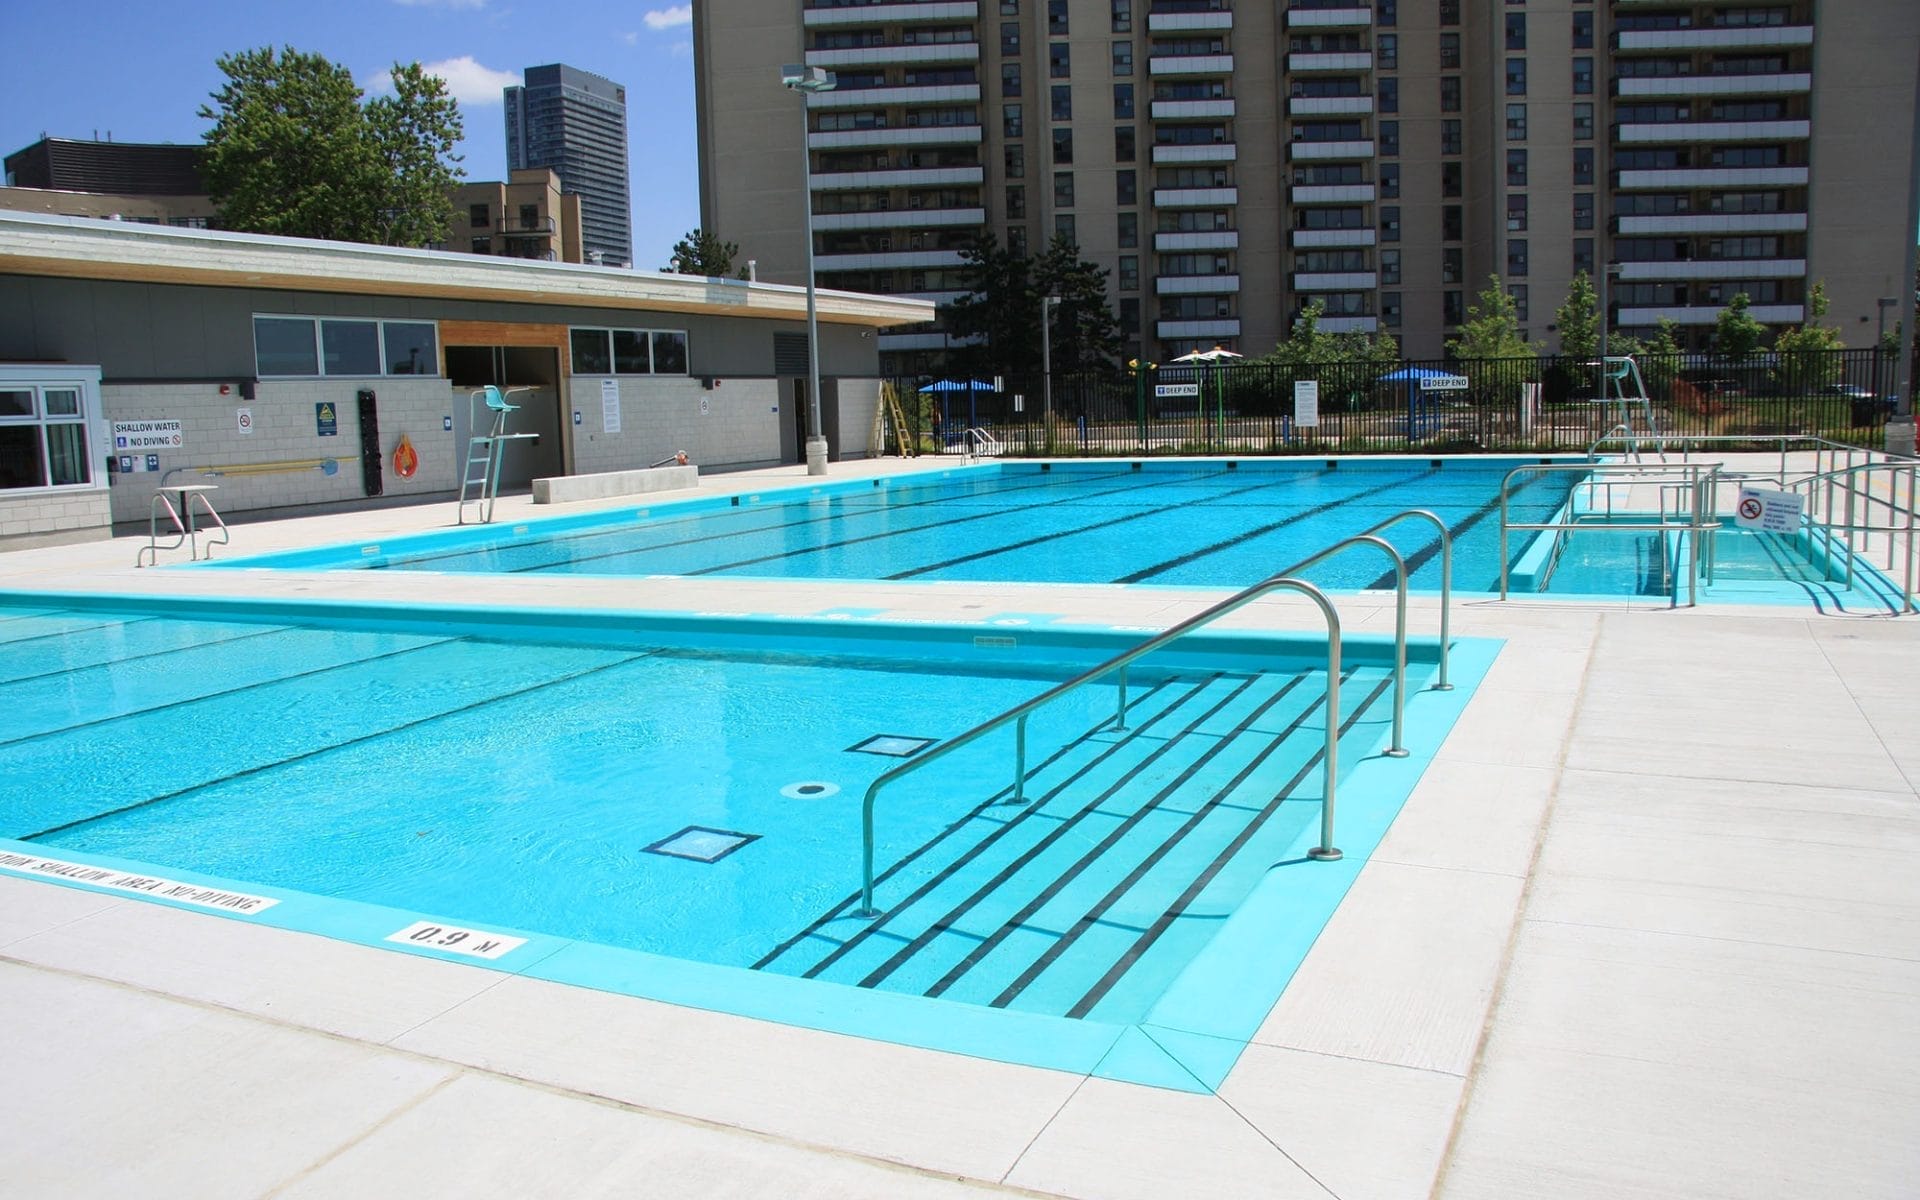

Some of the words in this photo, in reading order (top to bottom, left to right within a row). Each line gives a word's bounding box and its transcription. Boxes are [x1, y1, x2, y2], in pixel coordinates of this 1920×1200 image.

[1431, 379, 1450, 387] DEEP
[115, 423, 153, 433] SHALLOW
[154, 422, 181, 431] WATER
[130, 438, 142, 446] NO
[143, 436, 170, 446] DIVING
[31, 861, 114, 881] SHALLOW
[108, 876, 163, 891] AREA
[161, 885, 262, 910] NO-DIVING
[409, 926, 470, 946] 0.9
[471, 940, 501, 953] M
